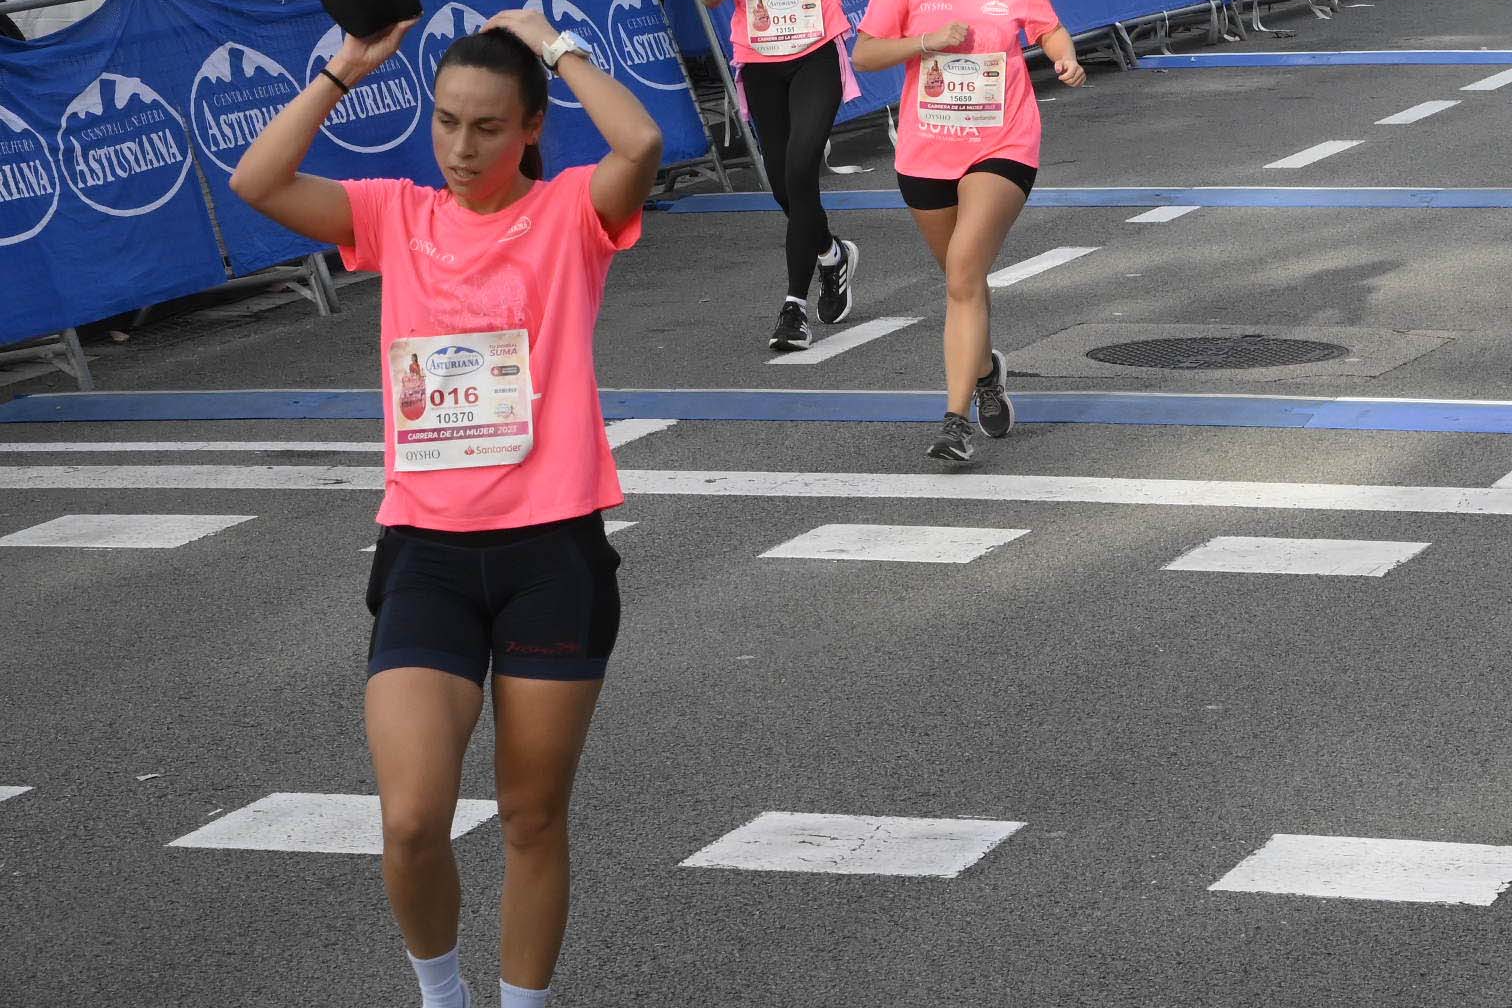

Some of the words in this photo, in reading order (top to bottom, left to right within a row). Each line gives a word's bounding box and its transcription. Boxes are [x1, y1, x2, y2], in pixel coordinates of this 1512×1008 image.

[920, 2, 953, 11] OYSHO
[773, 14, 797, 25] 016
[947, 81, 976, 92] 016
[489, 348, 518, 357] SUMA
[430, 358, 480, 370] ASTURIANA
[429, 386, 480, 407] 016
[436, 411, 474, 424] 10370
[407, 430, 438, 441] CARRERA
[440, 430, 452, 438] DE
[453, 429, 464, 437] LA
[466, 427, 495, 436] MUJER
[476, 444, 522, 455] Santander
[406, 449, 441, 462] OYSHO
